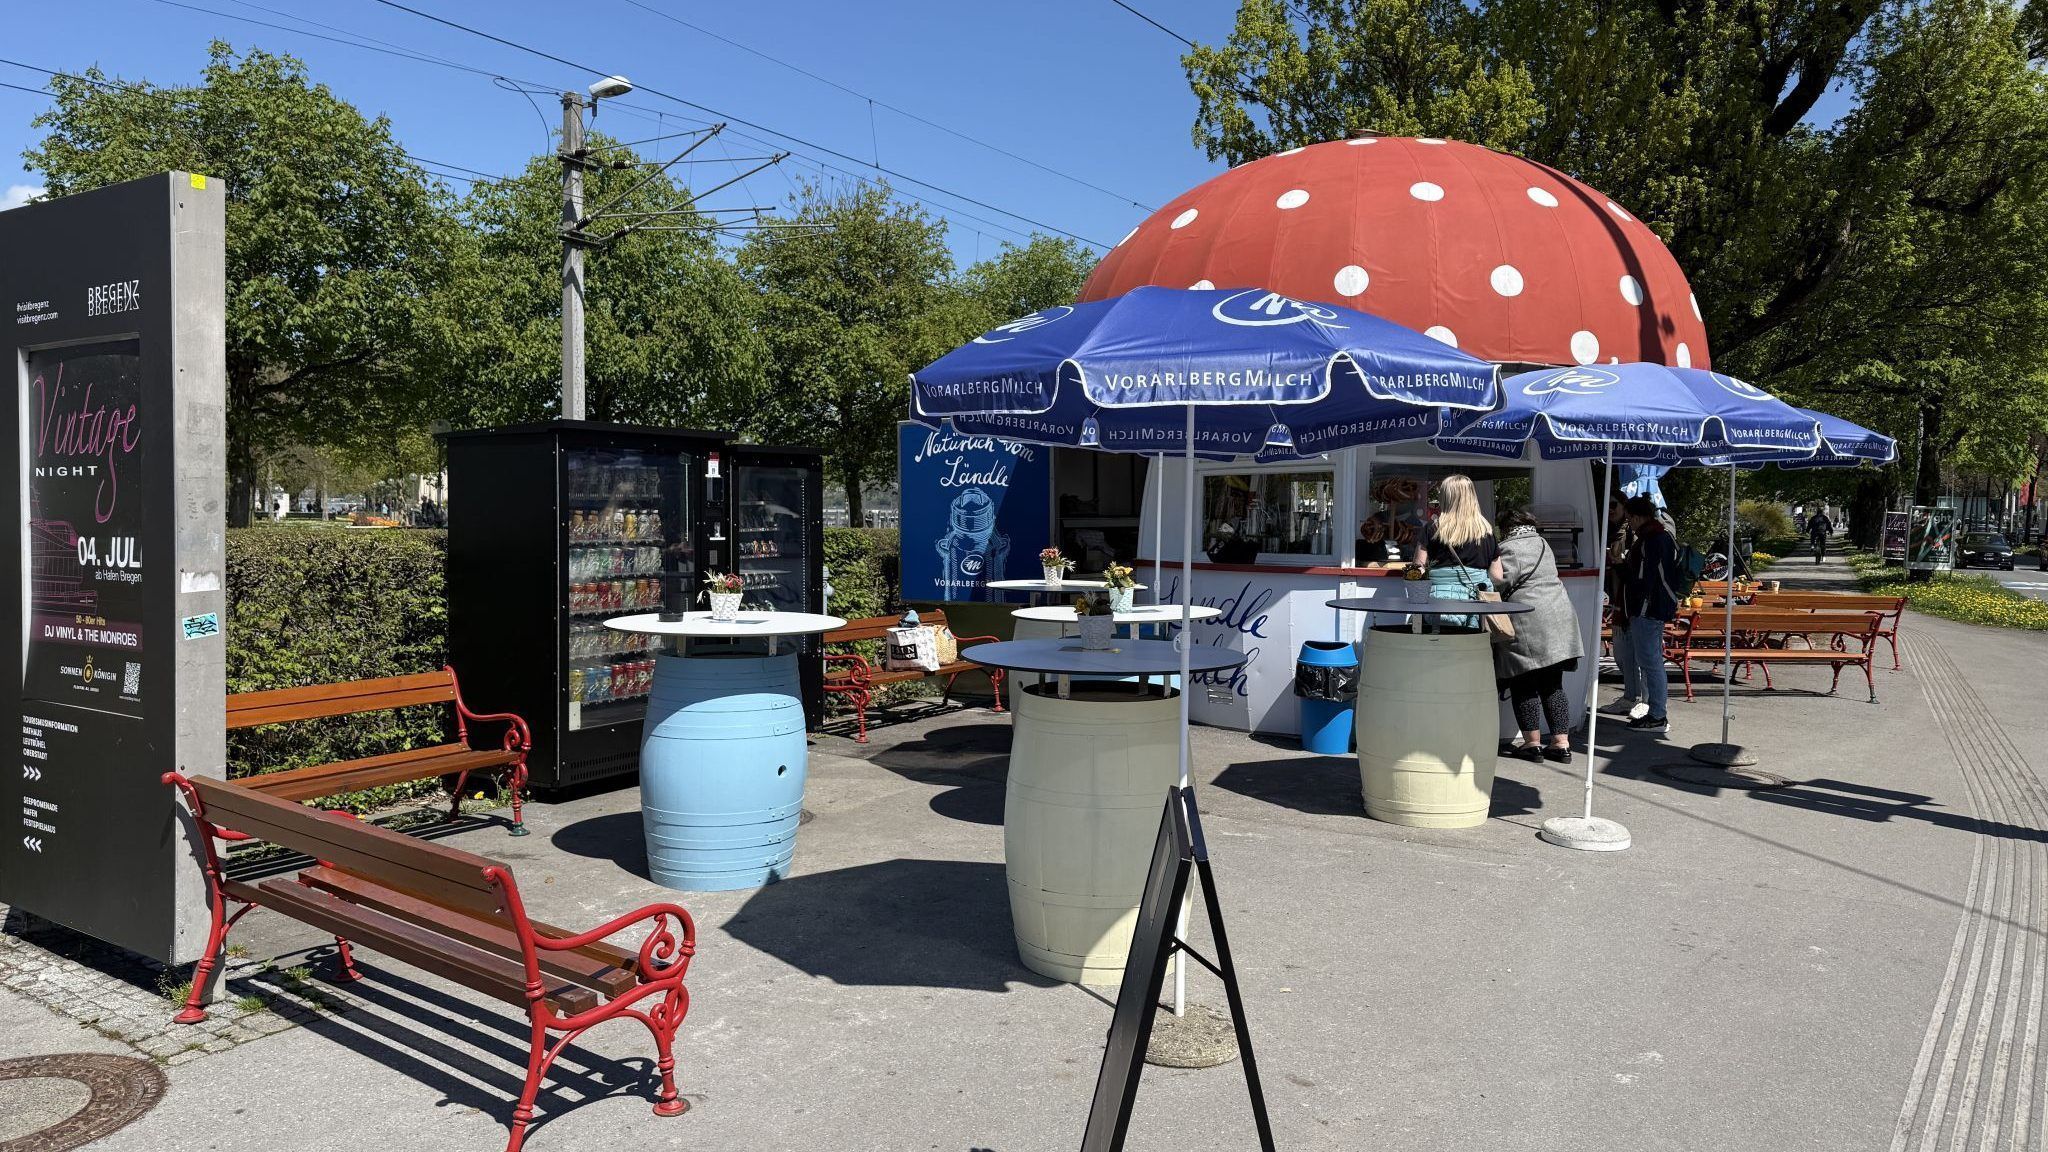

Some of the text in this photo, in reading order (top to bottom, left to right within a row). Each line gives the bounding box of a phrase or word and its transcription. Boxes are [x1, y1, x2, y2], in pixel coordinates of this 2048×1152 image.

[88, 280, 139, 306] BREGENZ
[16, 311, 59, 325] visitbregenz.com
[922, 377, 1043, 398] VORARLBERGMILCH
[1105, 370, 1312, 391] VORARLBERGMILCH
[1372, 374, 1485, 392] RARLBERGMILCH
[1558, 422, 1688, 436] VORARLBERGMILCH
[1731, 427, 1811, 440] VORARLBERGMILCH
[33, 360, 141, 524] Vintage
[915, 430, 1034, 462] Natürlich vom
[35, 465, 98, 477] NIGHT
[940, 455, 1009, 487] Ländle
[78, 536, 142, 568] 04. JUL
[96, 569, 142, 584] ab Hafen Bregen
[934, 578, 987, 589] VORARLBERG
[1160, 576, 1272, 638] Lndle
[45, 625, 137, 647] DJ VINYL & THE MONROES
